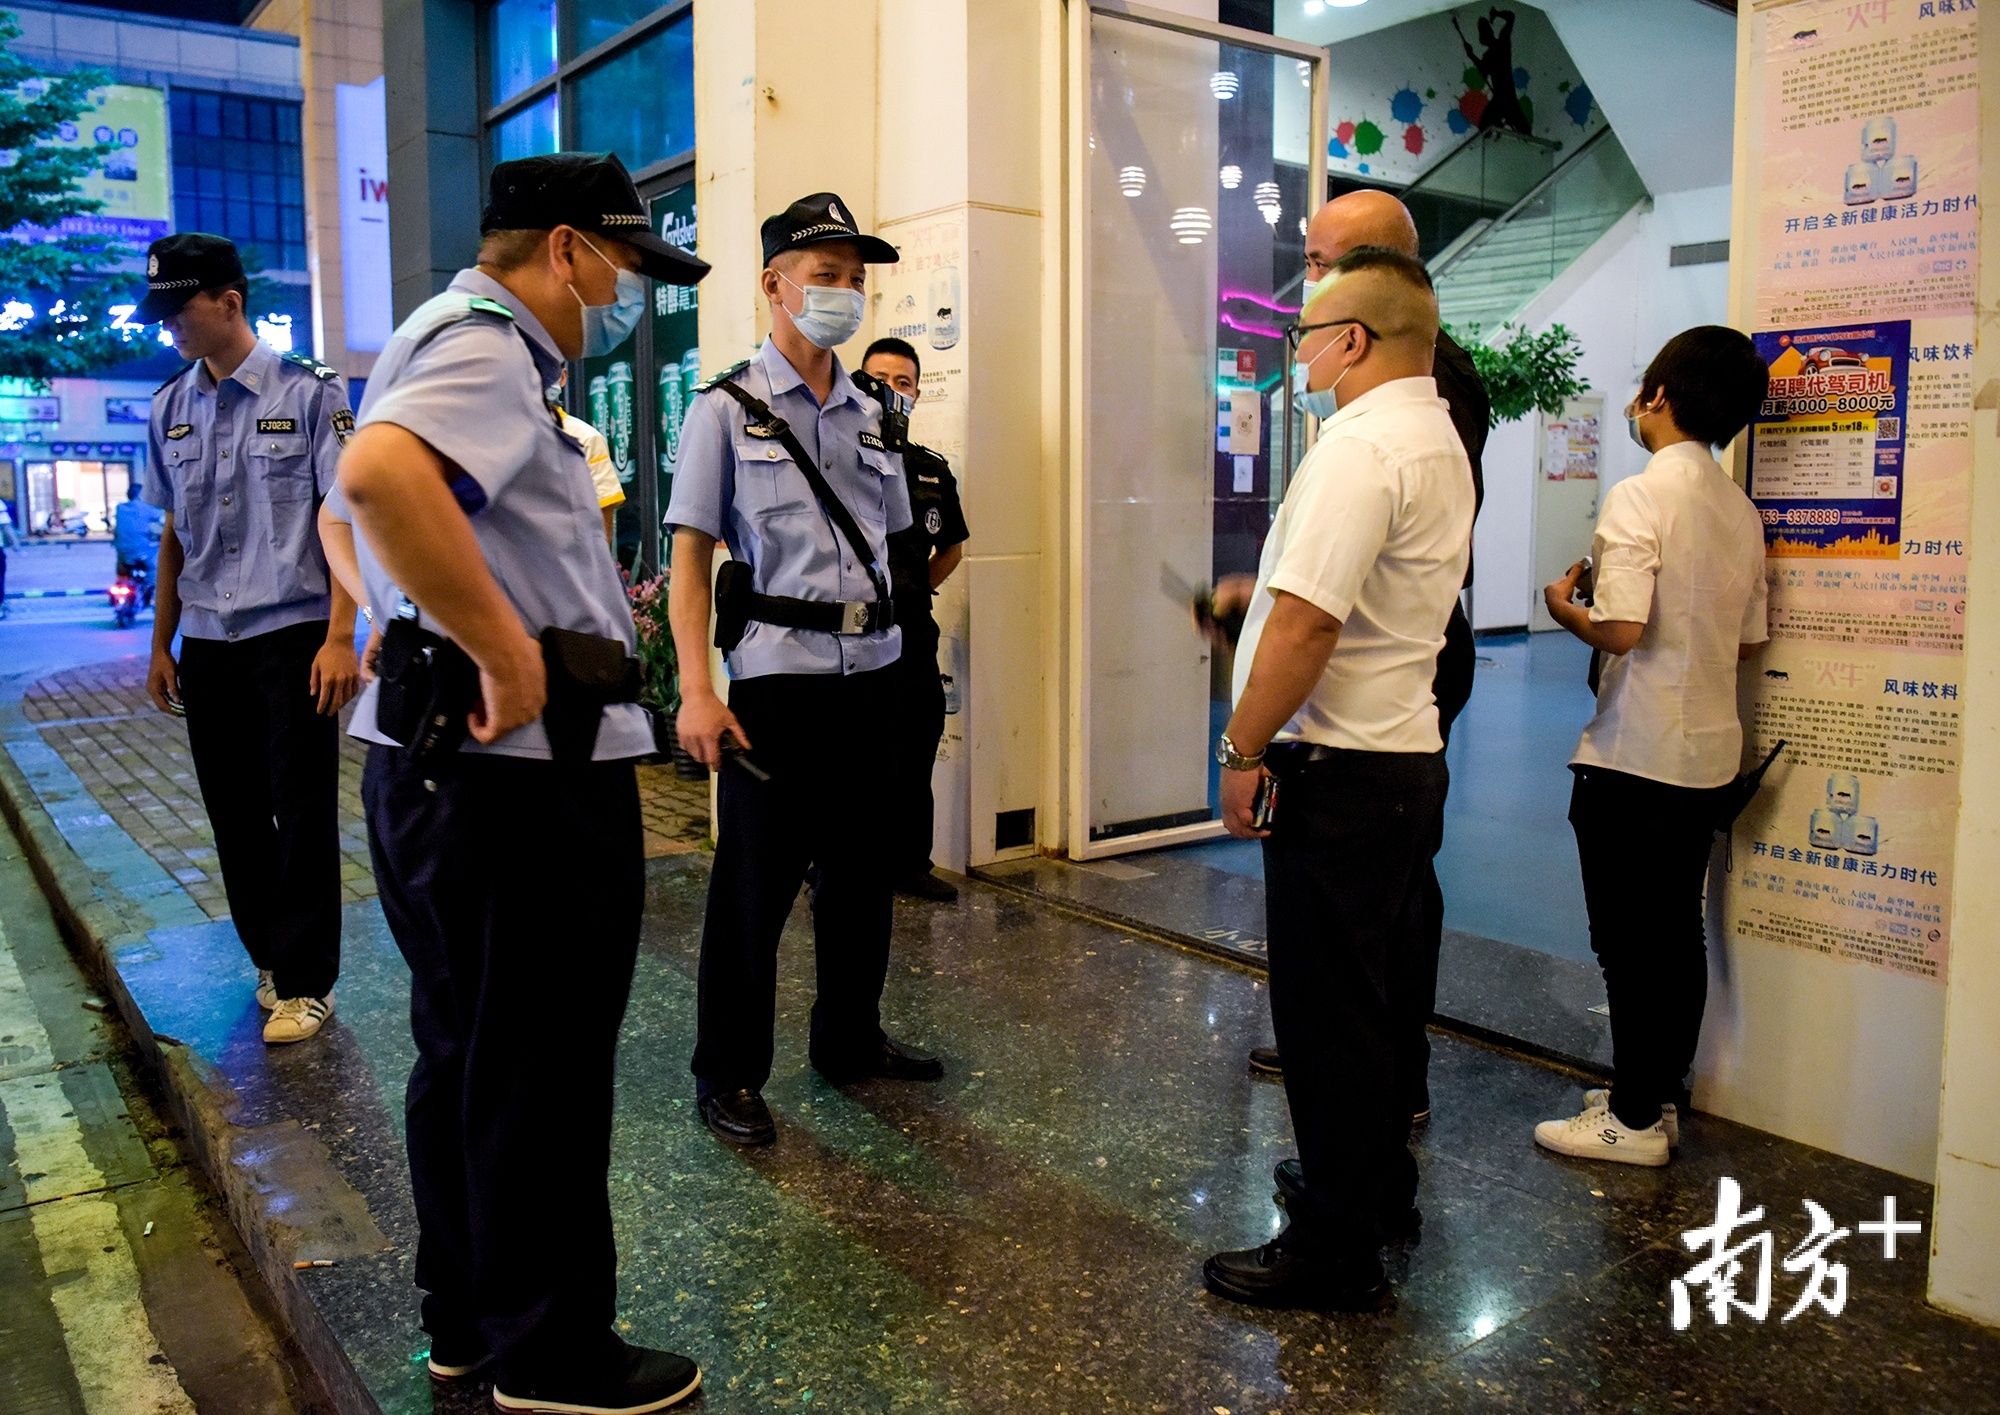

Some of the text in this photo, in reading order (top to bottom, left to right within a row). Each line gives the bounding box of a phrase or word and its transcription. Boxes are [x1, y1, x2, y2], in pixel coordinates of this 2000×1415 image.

[1769, 372, 1889, 397] 招聘代驾司机
[260, 421, 292, 431] FJ0232
[1883, 678, 1958, 700] 风味饮料
[1753, 841, 1938, 886] 开启全新健康活力时代
